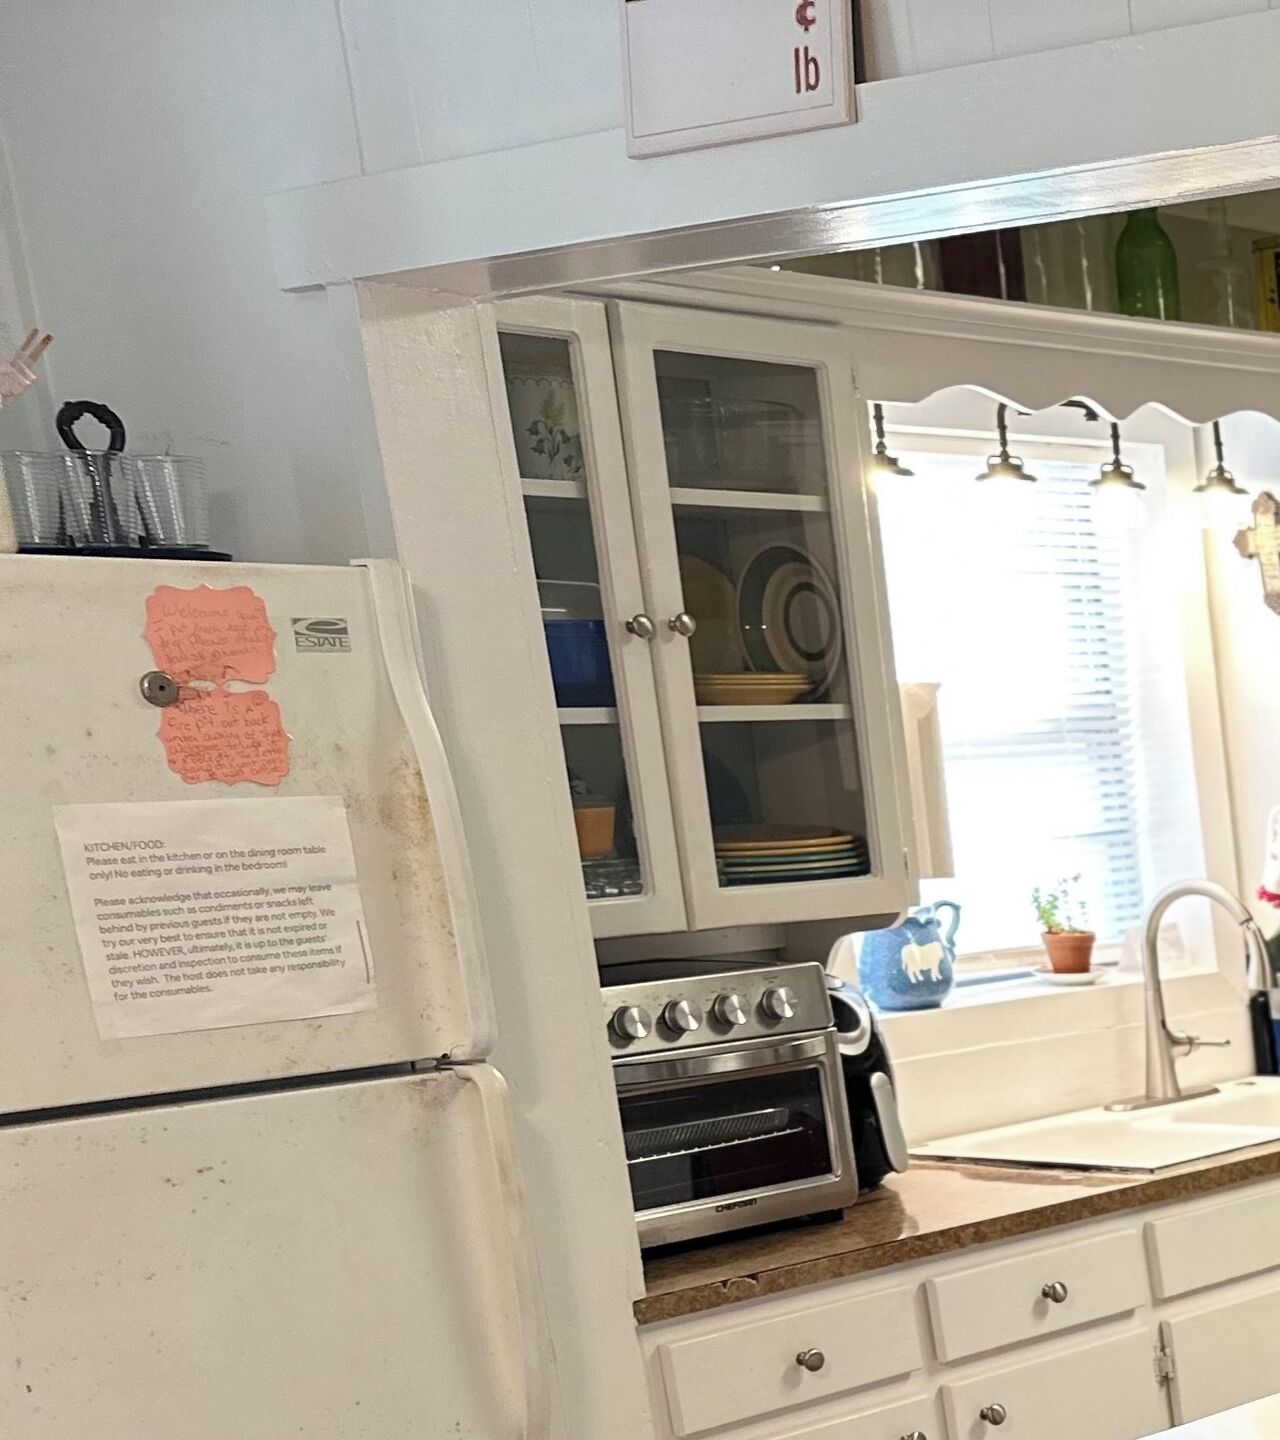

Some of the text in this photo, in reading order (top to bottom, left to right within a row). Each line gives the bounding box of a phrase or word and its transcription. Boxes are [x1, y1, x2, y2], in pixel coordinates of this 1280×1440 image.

[794, 45, 820, 94] lb
[294, 636, 350, 648] ESTATE
[83, 839, 166, 853] KITCHEN/FOOD:
[86, 845, 327, 867] Please eat in the kitchen or on the dining room table
[114, 869, 129, 879] No
[130, 867, 162, 880] eating
[163, 867, 174, 876] or
[175, 863, 214, 876] drinking
[214, 863, 223, 873] in
[224, 861, 241, 872] the
[241, 859, 289, 871] bedroom!
[94, 883, 332, 908] Please acknowledge that occasionally, we may leave
[96, 895, 314, 921] consumables such as condiments or snacks left
[98, 908, 336, 935] behind by previous guests if they are not empty. We
[101, 921, 328, 950] try our very best to ensure that it is not expired or
[108, 963, 158, 976] discretion
[159, 960, 177, 971] and
[178, 956, 227, 971] inspection
[227, 955, 239, 965] to
[239, 952, 282, 964] consume
[282, 949, 309, 960] these
[309, 946, 335, 957] items
[132, 946, 188, 960] HOWEVER,
[187, 942, 236, 955] ultimately,
[253, 940, 266, 951] up
[266, 938, 278, 948] to
[278, 937, 295, 947] the
[111, 958, 346, 990] they wish. The host does not take any responsibility
[114, 984, 214, 1002] for the consumables.
